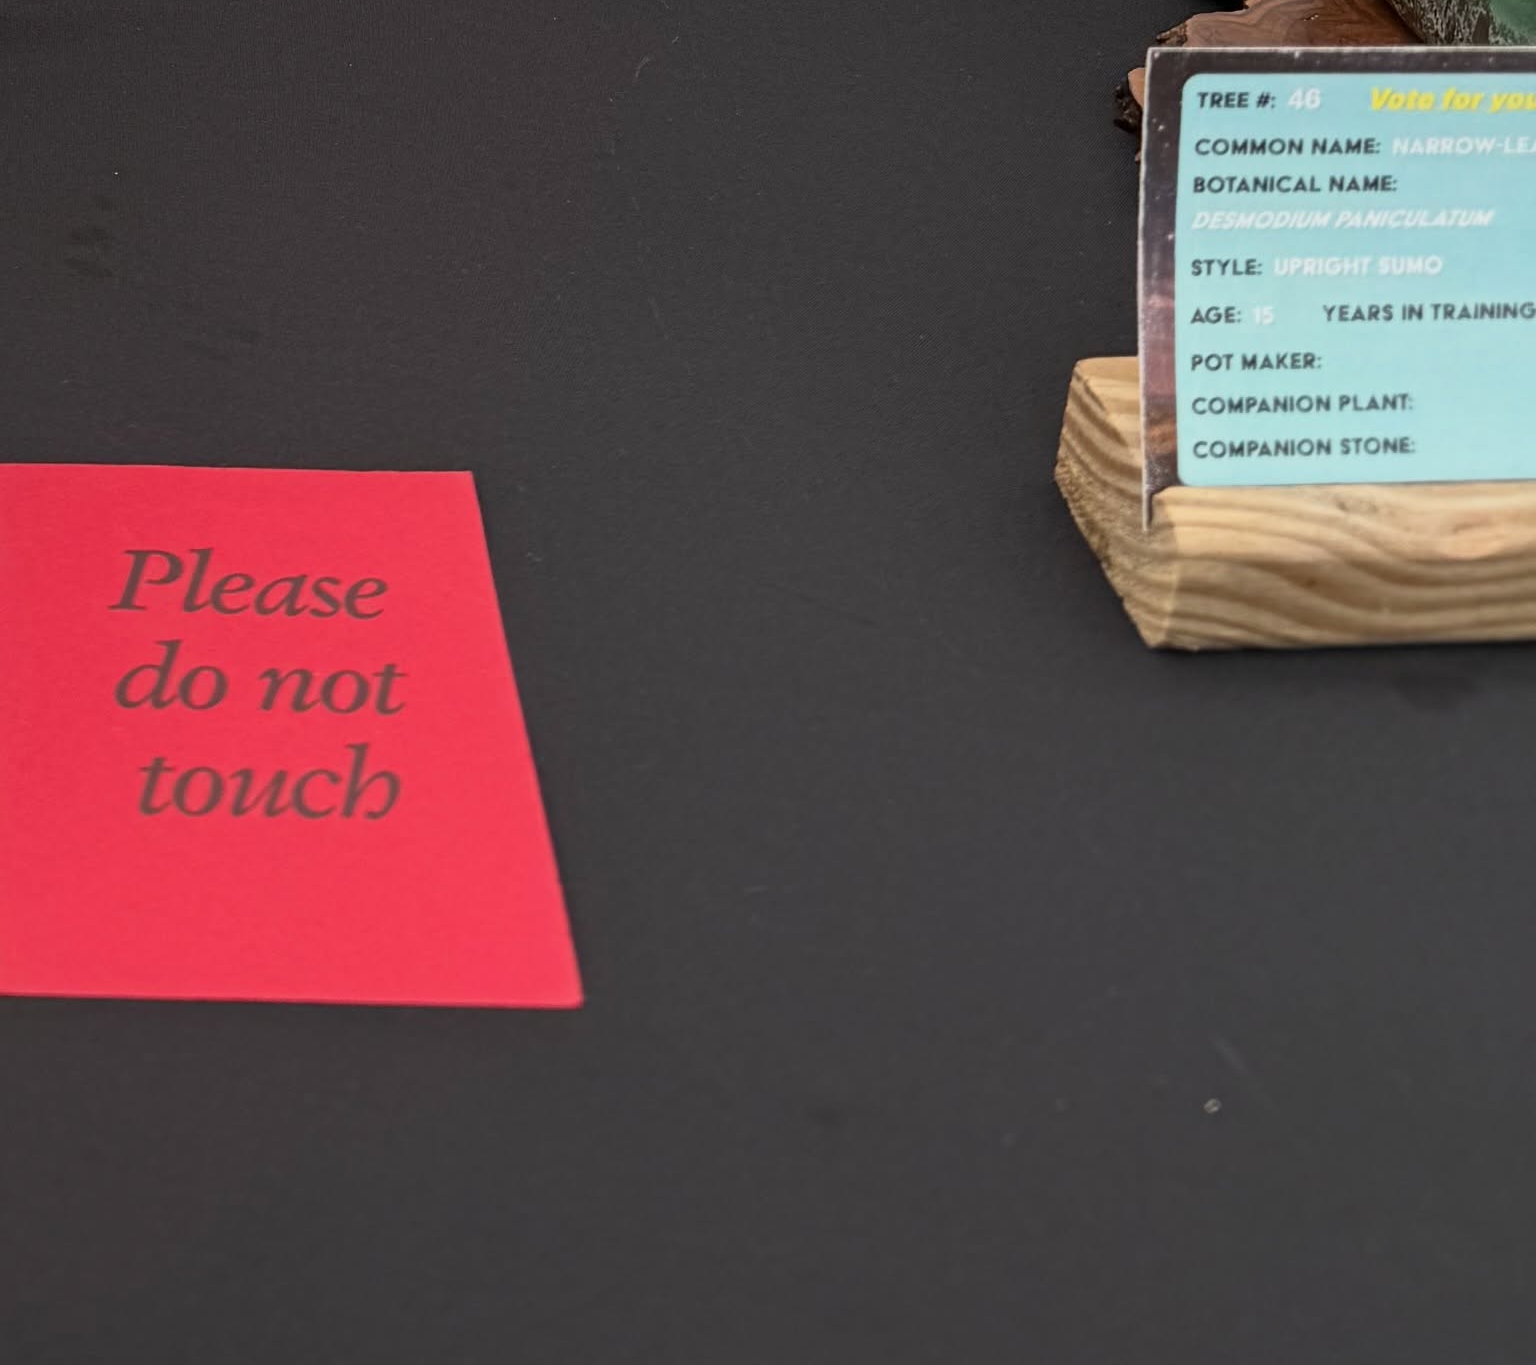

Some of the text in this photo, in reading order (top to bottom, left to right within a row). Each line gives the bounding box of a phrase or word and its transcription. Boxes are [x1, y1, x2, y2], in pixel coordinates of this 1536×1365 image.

[1197, 89, 1321, 110] TREE #: 46
[1370, 87, 1434, 111] Vote
[1442, 86, 1484, 111] for
[1194, 138, 1304, 157] COMMON
[1311, 137, 1382, 155] NAME:
[1193, 175, 1398, 194] BOTANICAL NAME:
[1191, 208, 1495, 230] DESMODIUM PANICULATUM
[1191, 255, 1443, 277] STYLE: UPRIGHT SUMO
[1191, 306, 1242, 324] AGE:
[1323, 304, 1394, 322] YEARS
[1402, 303, 1424, 321] IN
[1191, 353, 1322, 372] POT MAKER:
[1192, 394, 1414, 415] COMPANION PLANT:
[1193, 438, 1416, 459] COMPANION STONE:
[108, 548, 389, 620] Please
[114, 639, 408, 715] do not
[138, 743, 401, 820] touch
